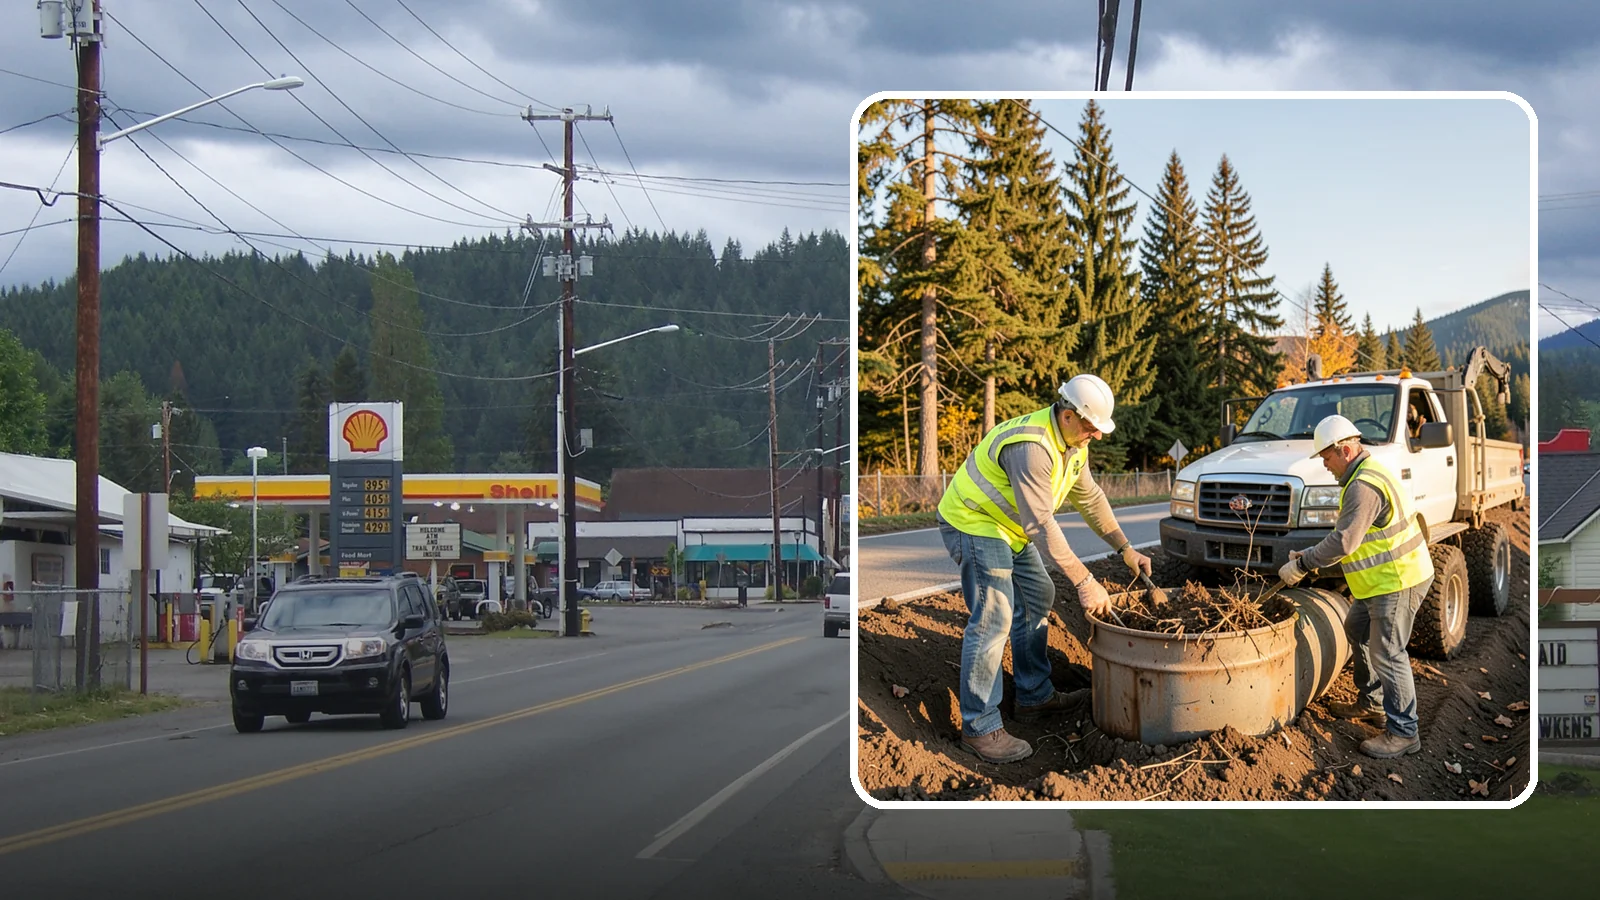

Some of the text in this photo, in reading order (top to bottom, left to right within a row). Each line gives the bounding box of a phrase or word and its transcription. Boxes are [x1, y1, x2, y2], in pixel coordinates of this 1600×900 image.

[366, 480, 384, 490] 395
[490, 484, 547, 499] Shell
[366, 494, 384, 504] 405
[366, 508, 384, 518] 415
[366, 522, 384, 532] 429
